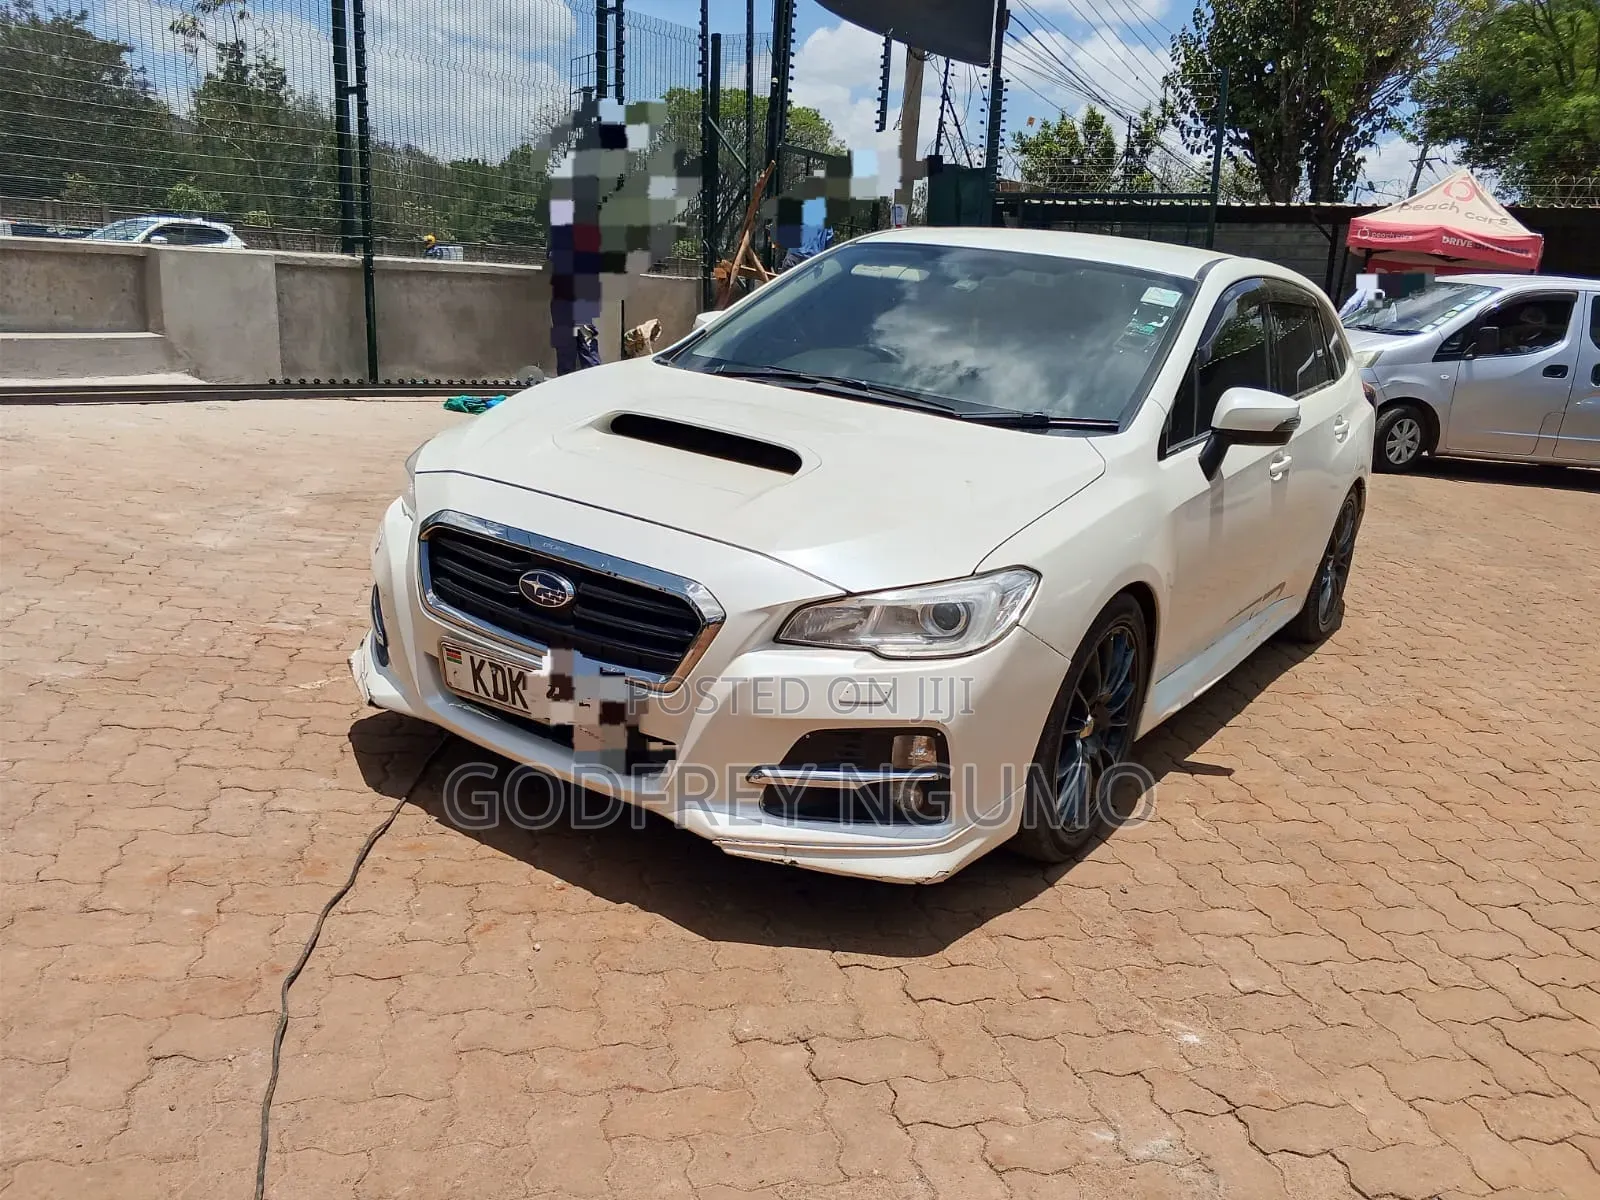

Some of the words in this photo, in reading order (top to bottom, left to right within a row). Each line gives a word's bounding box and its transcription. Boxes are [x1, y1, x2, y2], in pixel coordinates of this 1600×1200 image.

[1398, 201, 1460, 215] peach
[1464, 211, 1510, 227] cars
[1441, 236, 1473, 248] DRIVE
[469, 655, 529, 710] KDK
